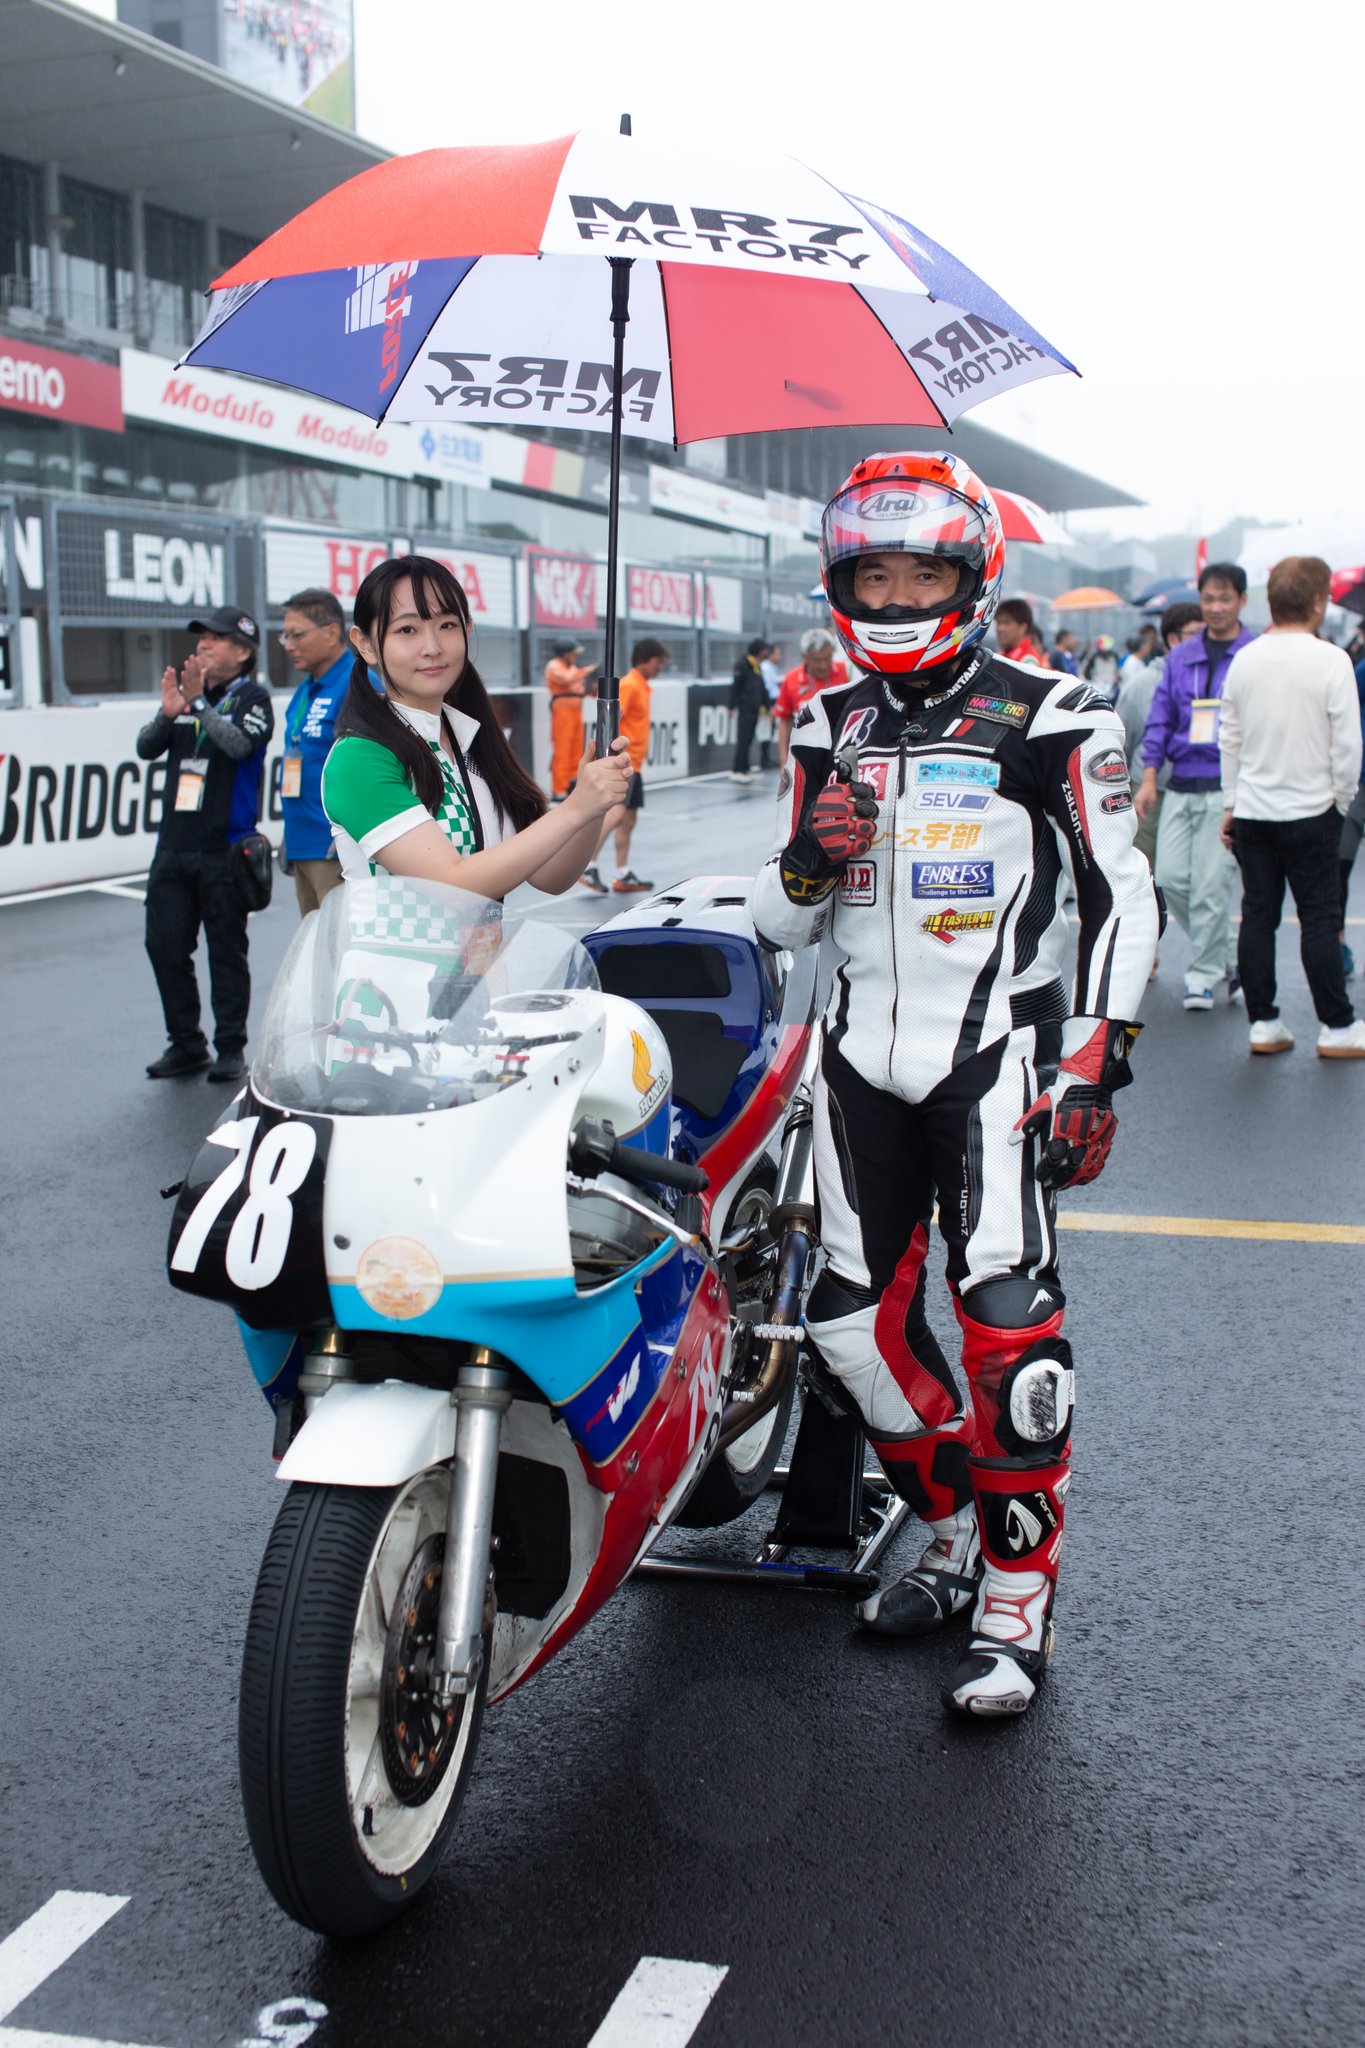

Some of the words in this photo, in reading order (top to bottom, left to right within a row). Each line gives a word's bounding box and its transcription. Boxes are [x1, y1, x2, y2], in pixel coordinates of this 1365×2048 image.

[569, 194, 863, 246] MR7
[576, 222, 871, 269] FACTORY
[161, 379, 274, 430] Modulo
[296, 412, 390, 458] Modulo
[104, 529, 225, 608] LEON
[969, 695, 1004, 712] HAPPY
[1004, 702, 1026, 717] END
[920, 792, 960, 808] SEV
[918, 864, 990, 884] ENDLESS
[918, 888, 948, 897] Challenge
[943, 912, 980, 926] FASTER
[639, 1070, 669, 1118] HONDA
[170, 1116, 317, 1291] 78
